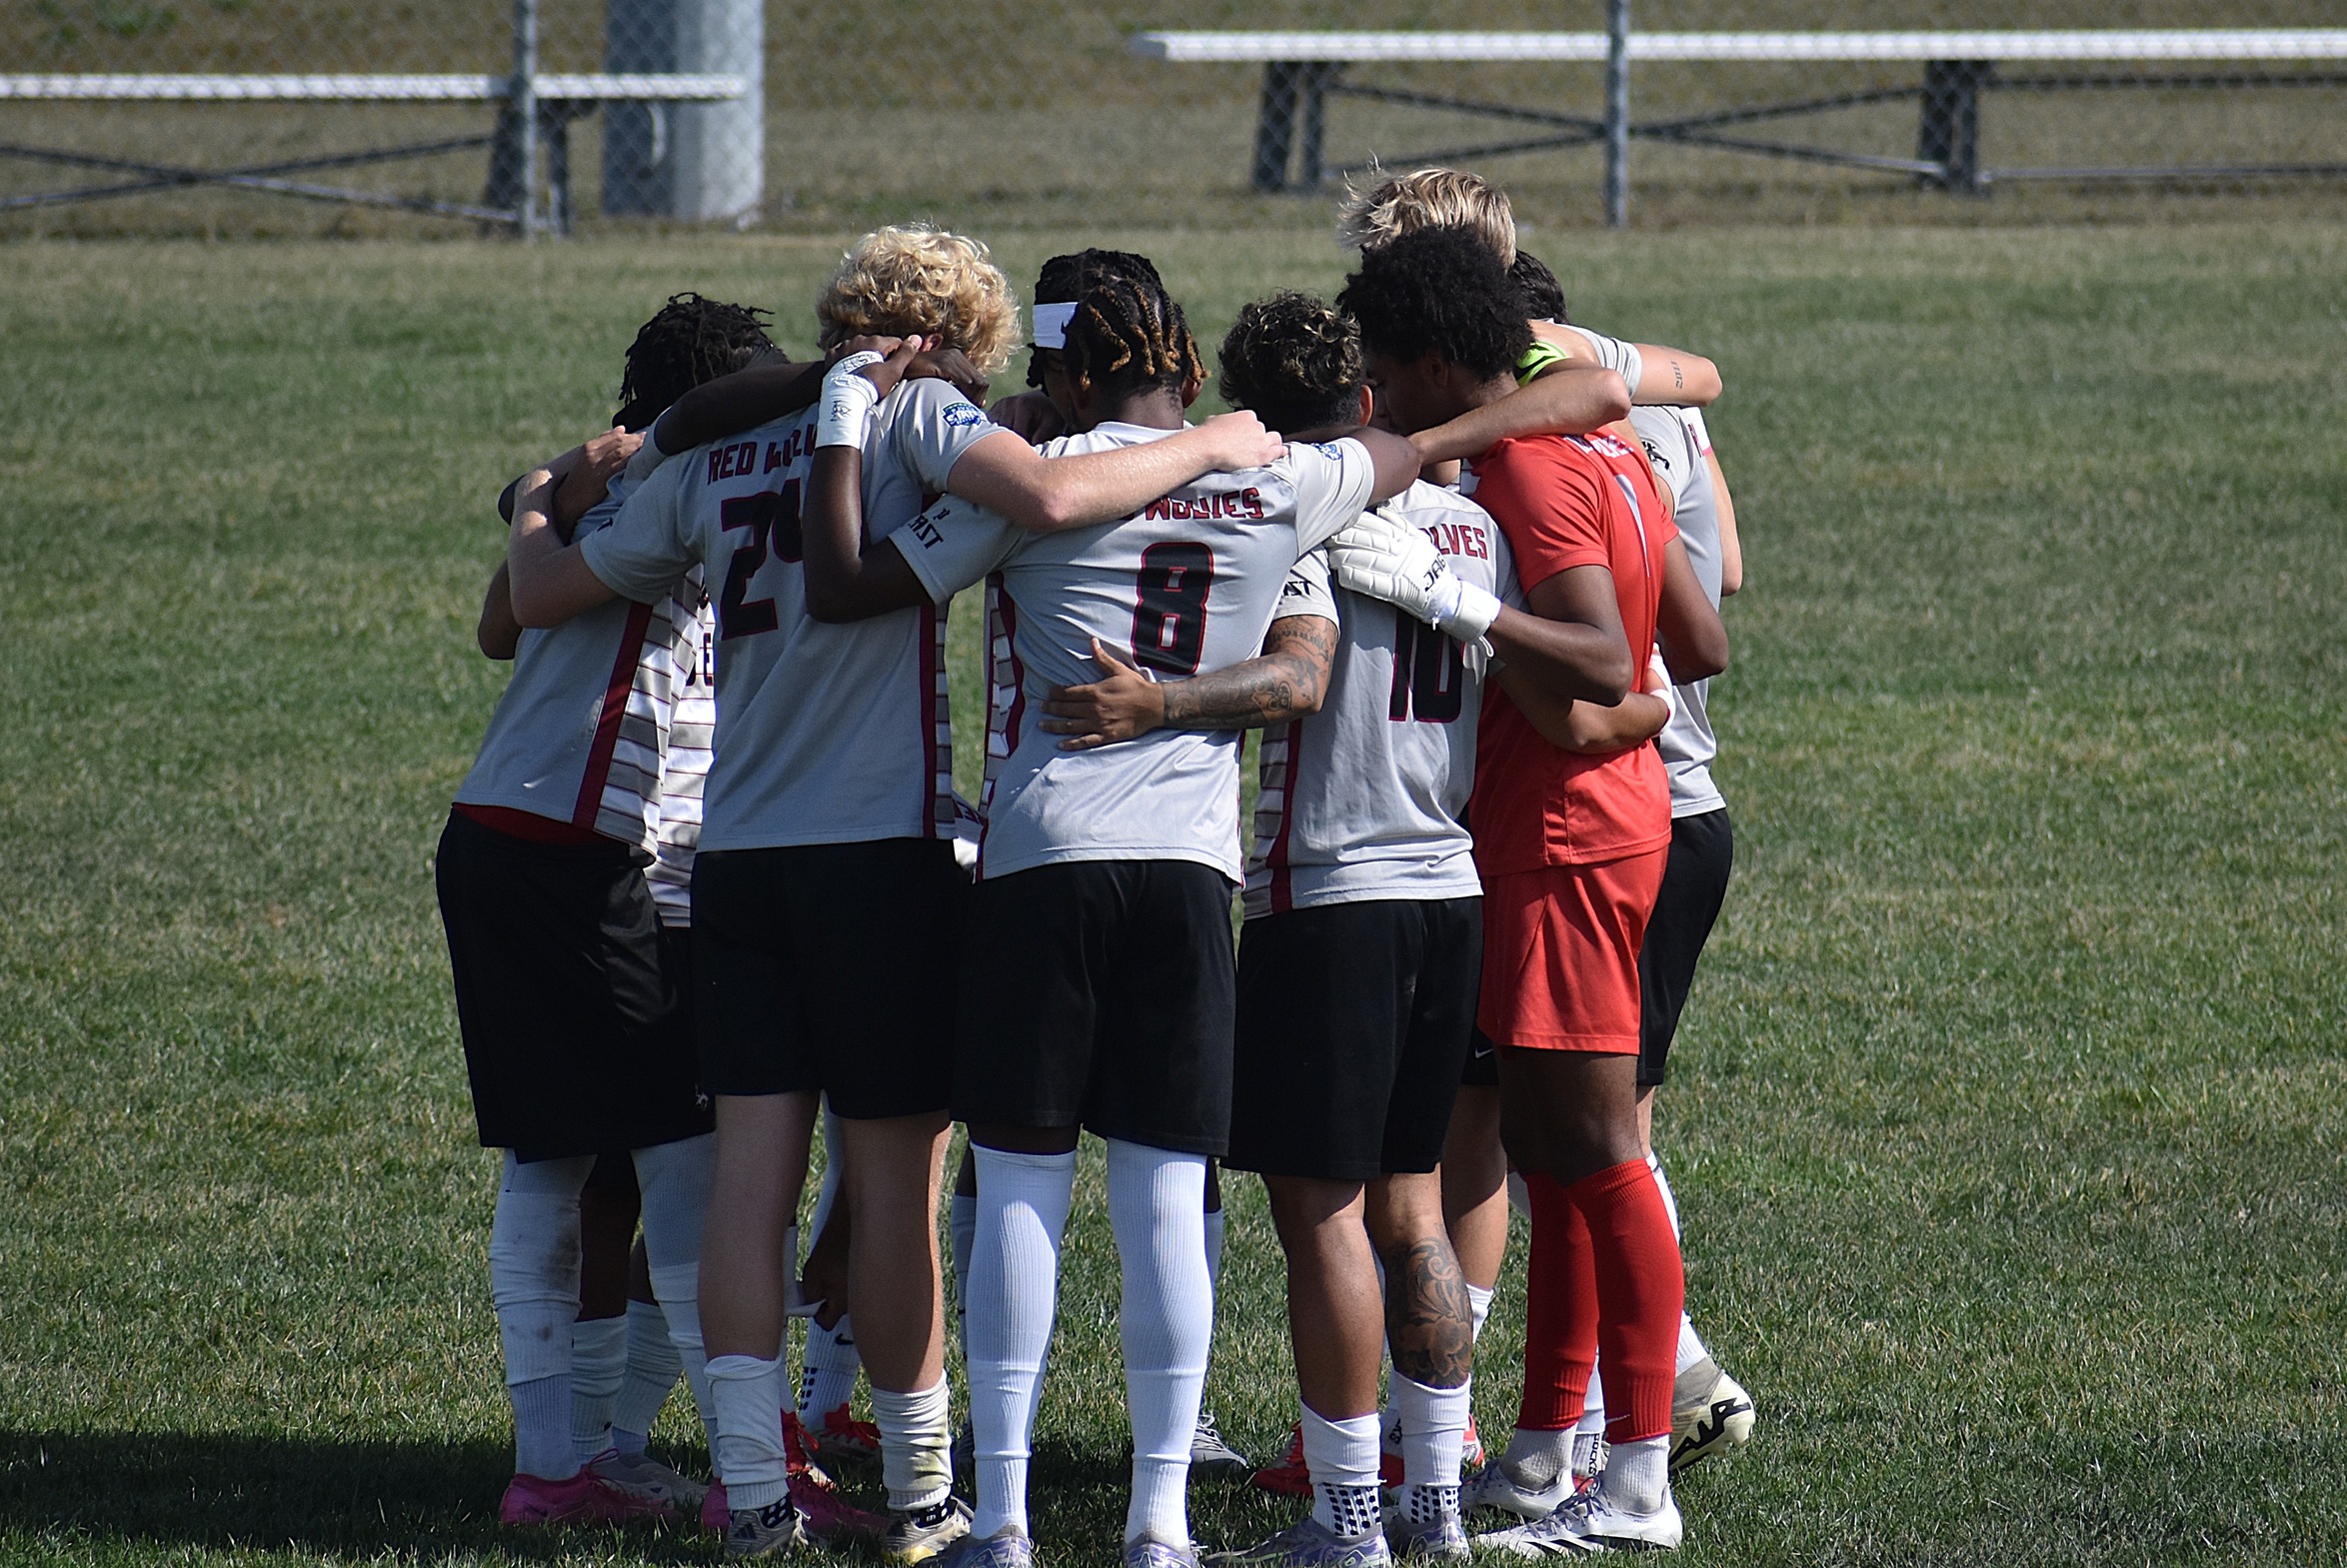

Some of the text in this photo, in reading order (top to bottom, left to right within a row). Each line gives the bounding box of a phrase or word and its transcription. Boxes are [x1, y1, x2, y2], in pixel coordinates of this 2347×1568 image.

[708, 442, 757, 485] RED
[1146, 487, 1263, 521] WOLVES
[908, 515, 945, 549] AST
[1418, 524, 1488, 561] LVES
[1130, 542, 1214, 676] 8
[1388, 610, 1464, 723] 10
